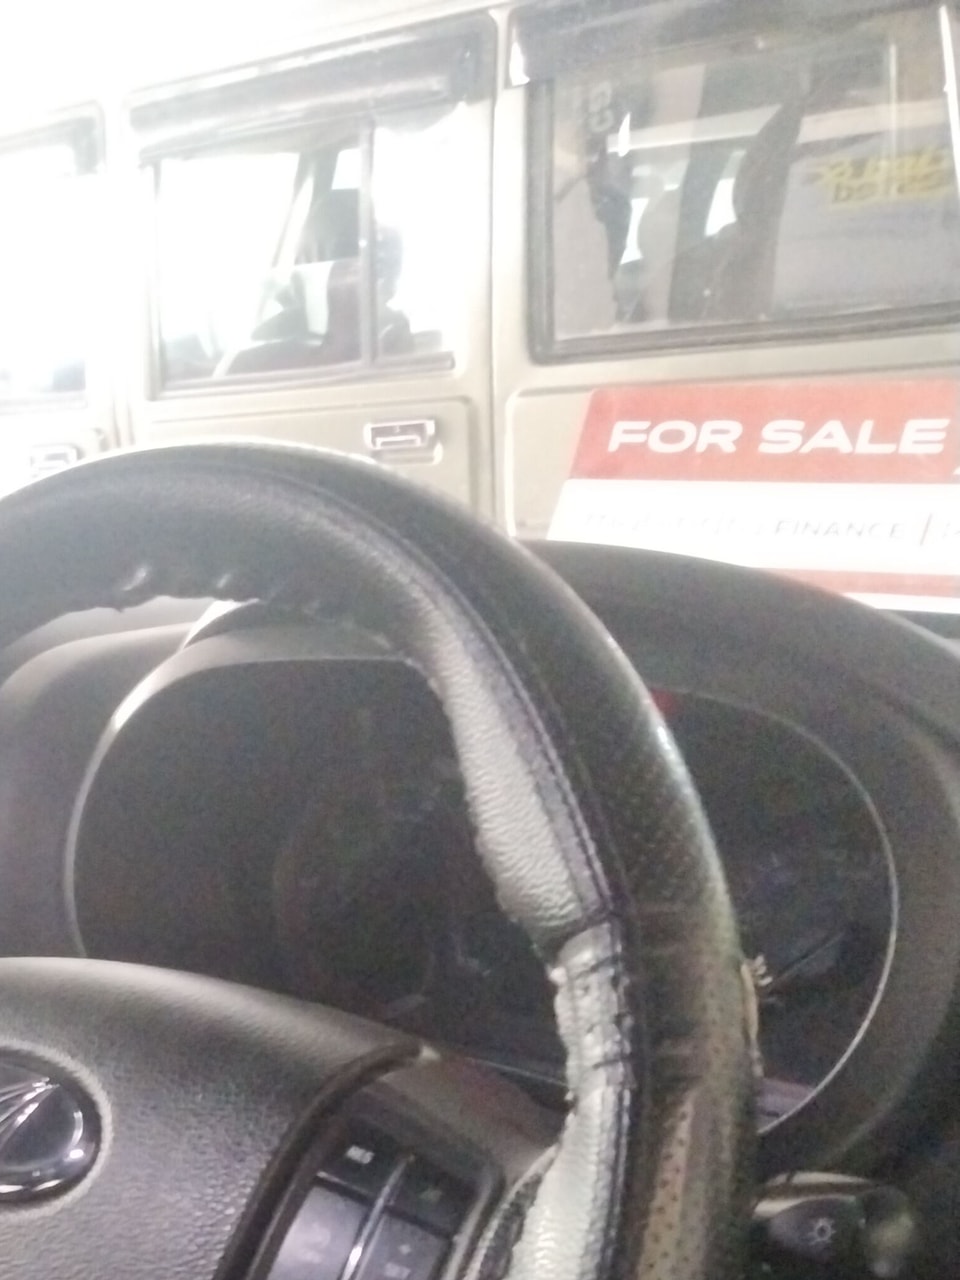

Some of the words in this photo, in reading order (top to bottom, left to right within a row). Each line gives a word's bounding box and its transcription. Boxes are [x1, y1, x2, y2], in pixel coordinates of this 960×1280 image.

[608, 420, 743, 453] FOR
[758, 418, 950, 454] SALE
[774, 518, 906, 540] FINANCE
